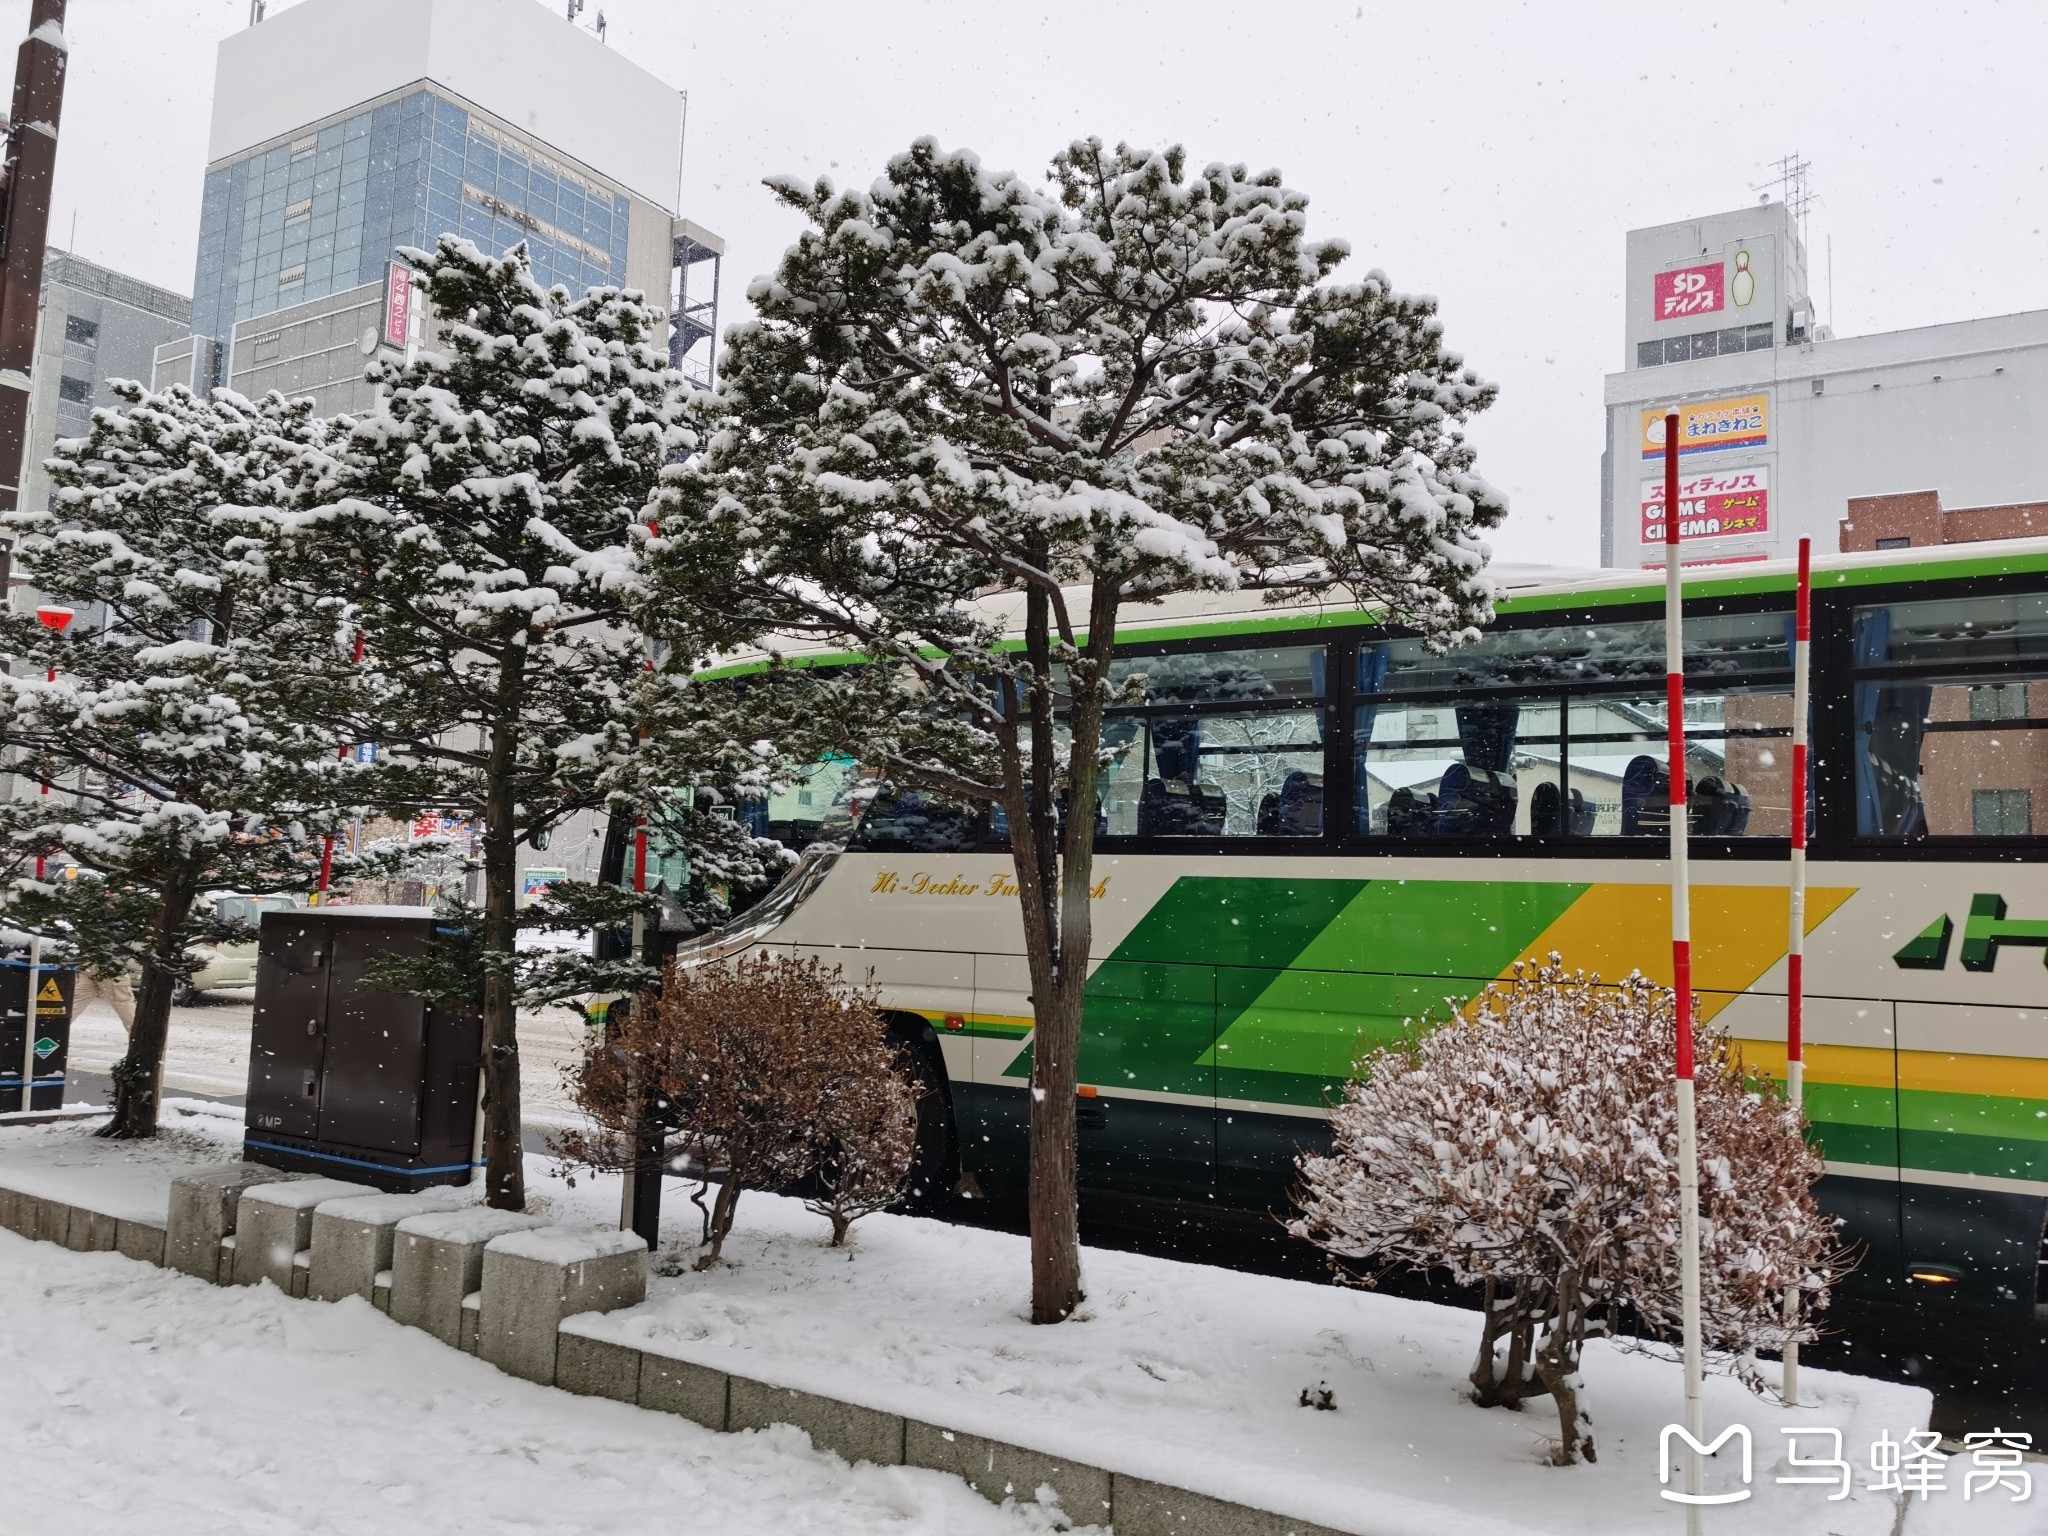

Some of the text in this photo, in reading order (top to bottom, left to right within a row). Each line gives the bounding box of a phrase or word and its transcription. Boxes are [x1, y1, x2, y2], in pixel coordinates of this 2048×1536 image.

[1673, 272, 1707, 295] SD
[1664, 290, 1714, 316] ディノス
[1687, 415, 1763, 438] まねきねこ
[1650, 474, 1757, 499] スイディノス
[1645, 499, 1707, 520] GME
[1723, 496, 1758, 511] ゲーム
[1645, 518, 1720, 541] CIEMA
[1722, 517, 1758, 531] シネマ
[870, 871, 980, 896] Hi-Decker
